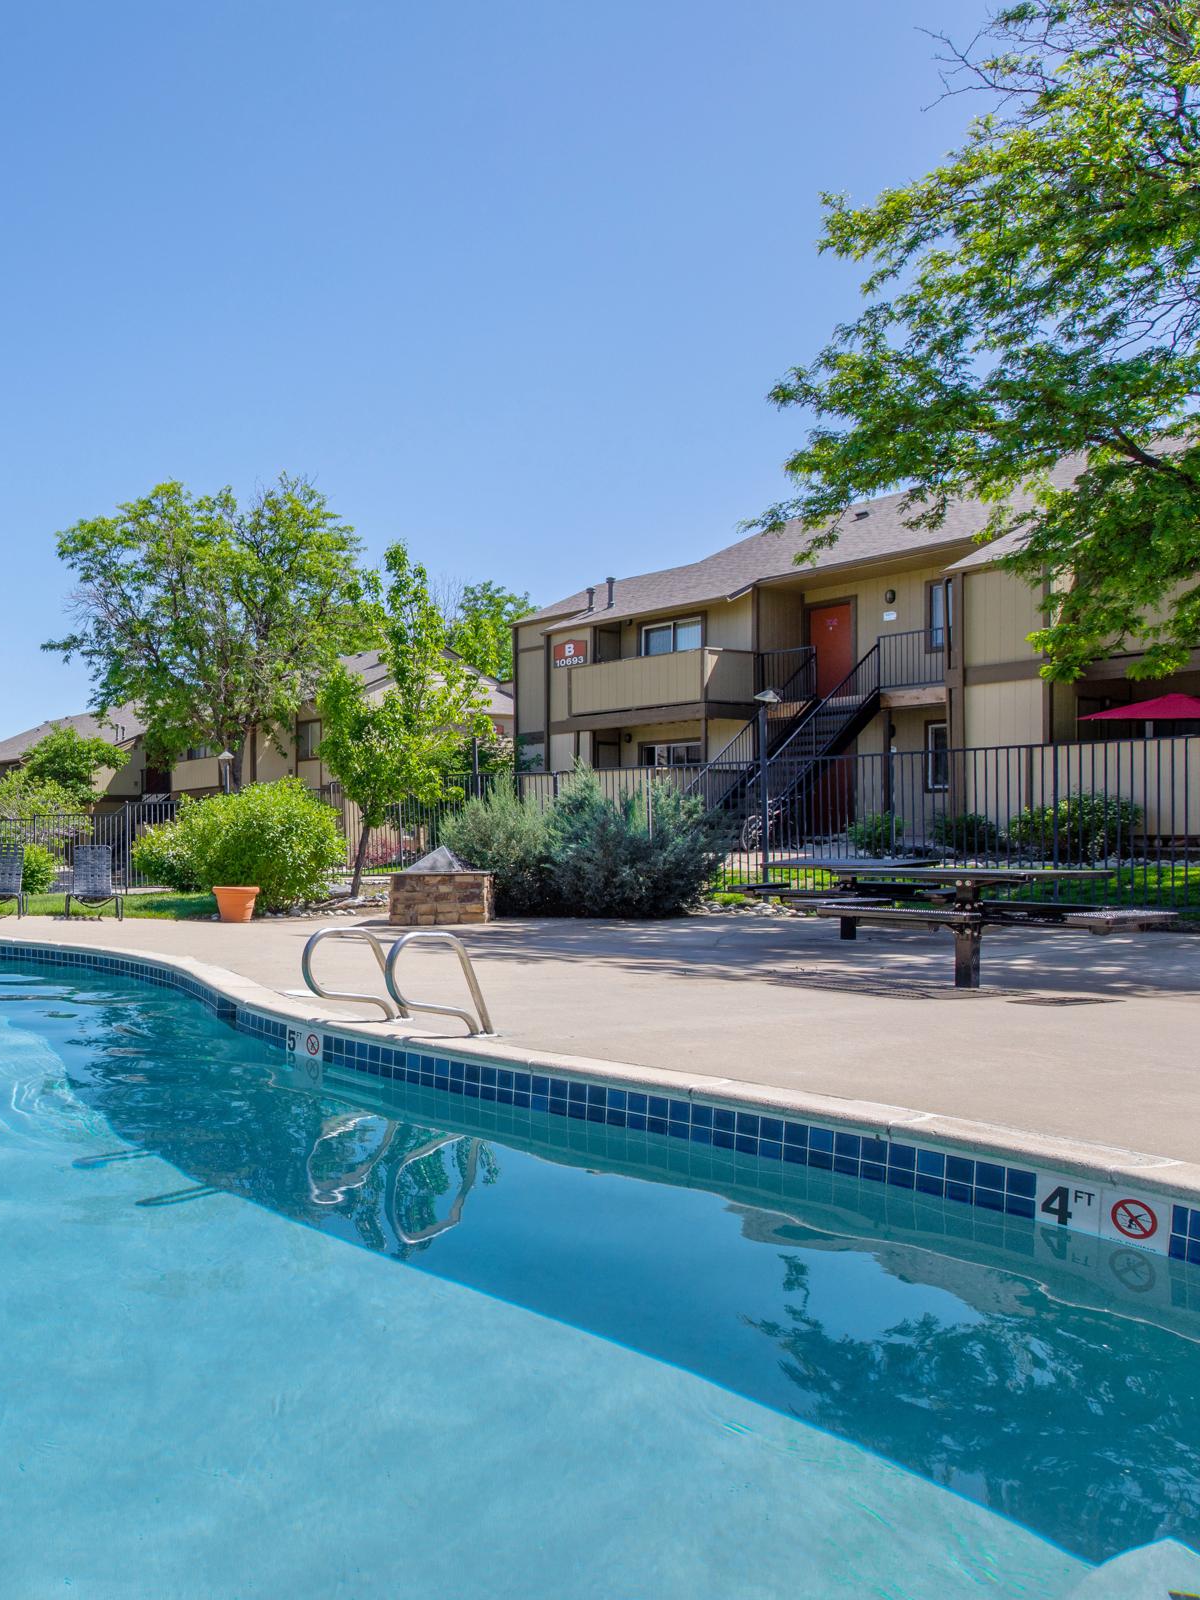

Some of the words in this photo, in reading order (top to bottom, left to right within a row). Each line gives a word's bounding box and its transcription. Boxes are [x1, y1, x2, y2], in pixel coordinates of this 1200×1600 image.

[565, 643, 575, 657] B
[555, 656, 584, 667] 10693
[288, 1029, 296, 1051] 5
[296, 1032, 302, 1040] FT
[1041, 1186, 1072, 1225] 4
[1074, 1190, 1095, 1206] FT
